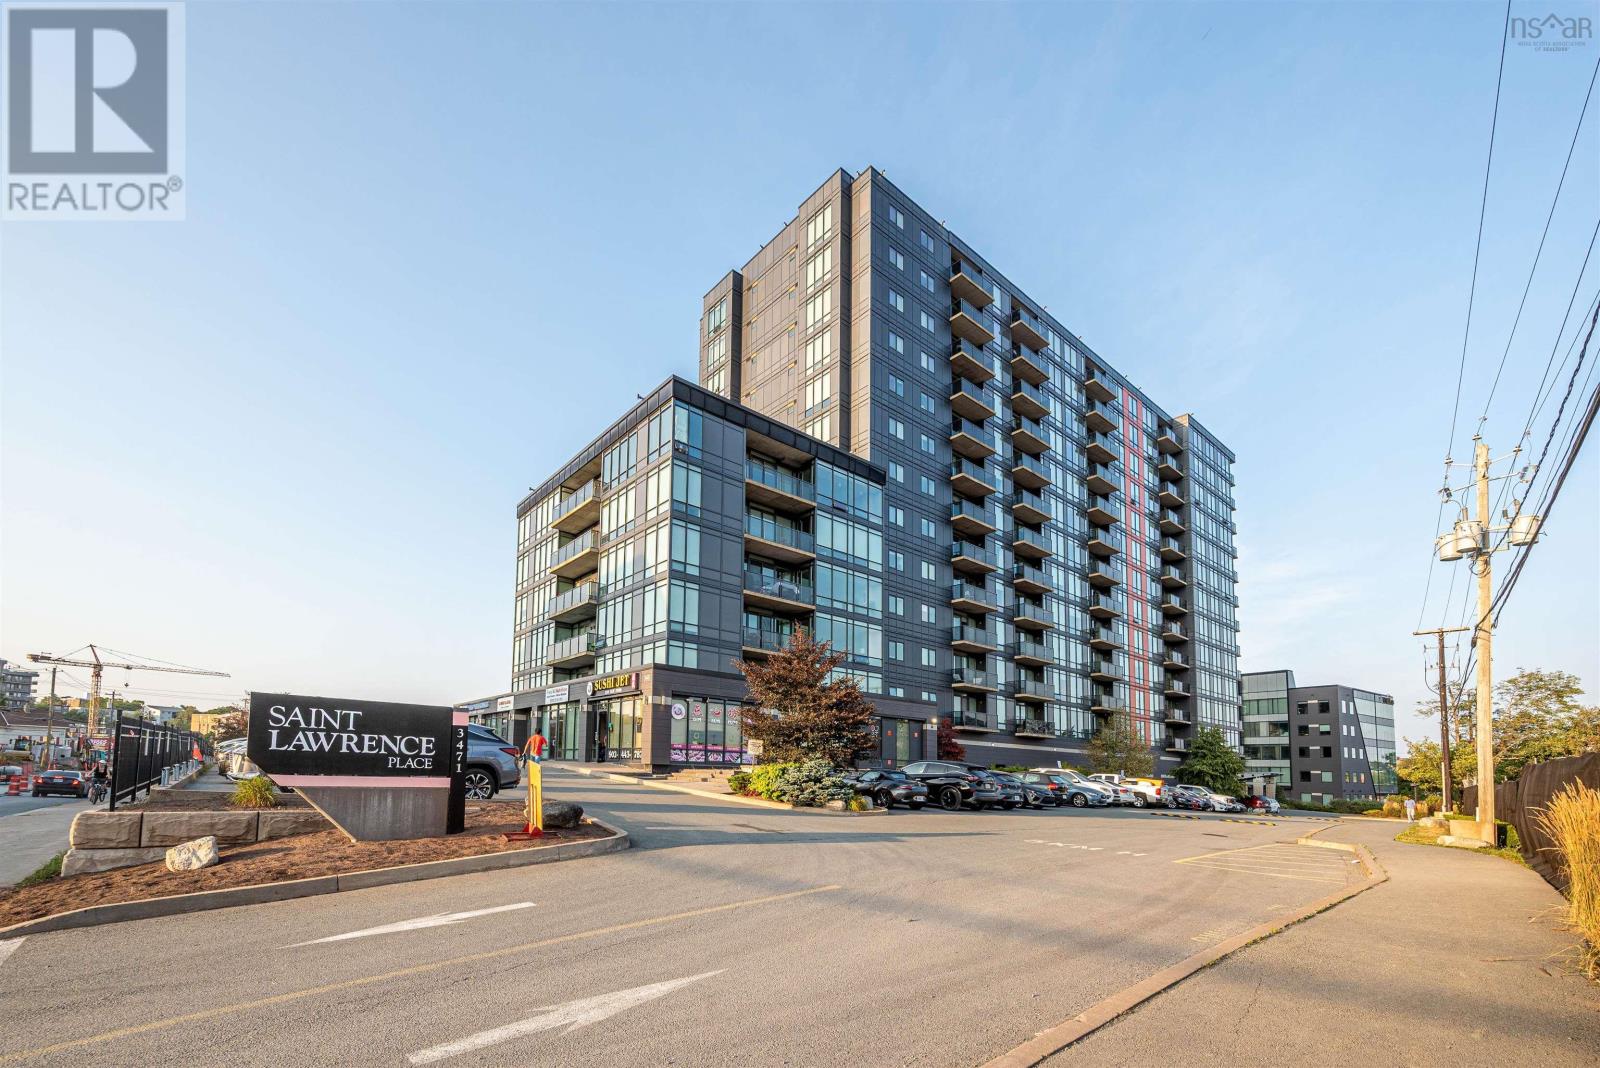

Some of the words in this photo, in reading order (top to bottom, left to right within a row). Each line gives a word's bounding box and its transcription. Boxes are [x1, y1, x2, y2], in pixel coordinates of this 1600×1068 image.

[594, 676, 614, 691] SUSHI
[615, 674, 630, 687] JET
[268, 705, 363, 731] SAINT
[268, 729, 436, 756] LAWRENCE
[388, 757, 433, 769] PLACE
